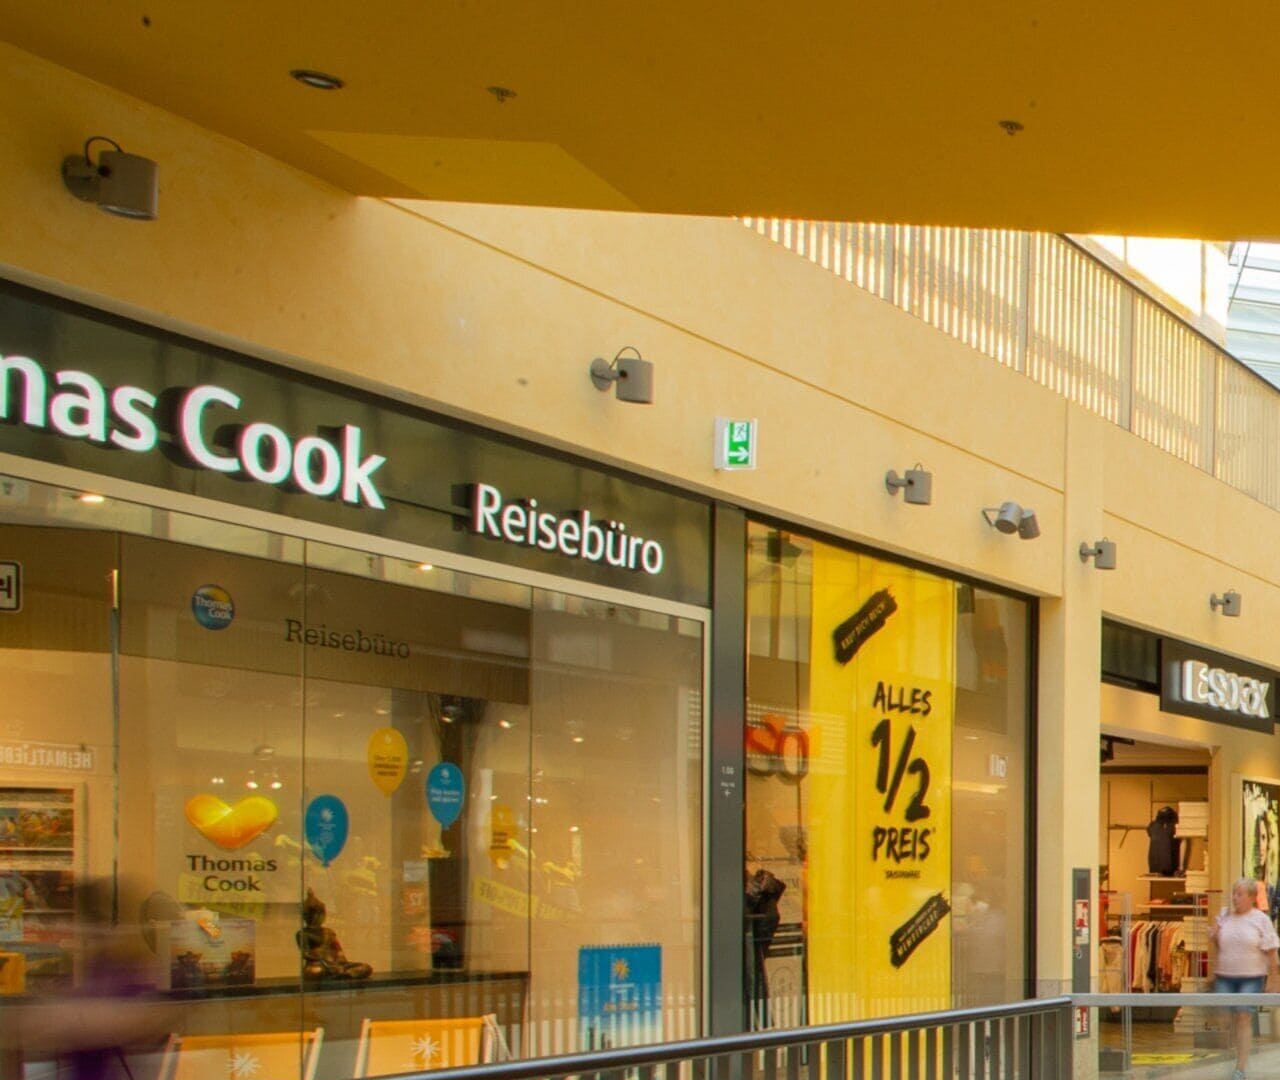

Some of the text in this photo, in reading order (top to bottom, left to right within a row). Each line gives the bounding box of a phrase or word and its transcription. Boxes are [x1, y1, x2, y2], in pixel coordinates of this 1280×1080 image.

[177, 386, 387, 510] Cook
[474, 483, 664, 576] Reisebüro
[285, 618, 412, 659] Reisebüro
[872, 680, 932, 716] ALLES
[871, 718, 932, 823] 1/2
[186, 855, 278, 872] Thomas
[203, 875, 262, 892] Cook
